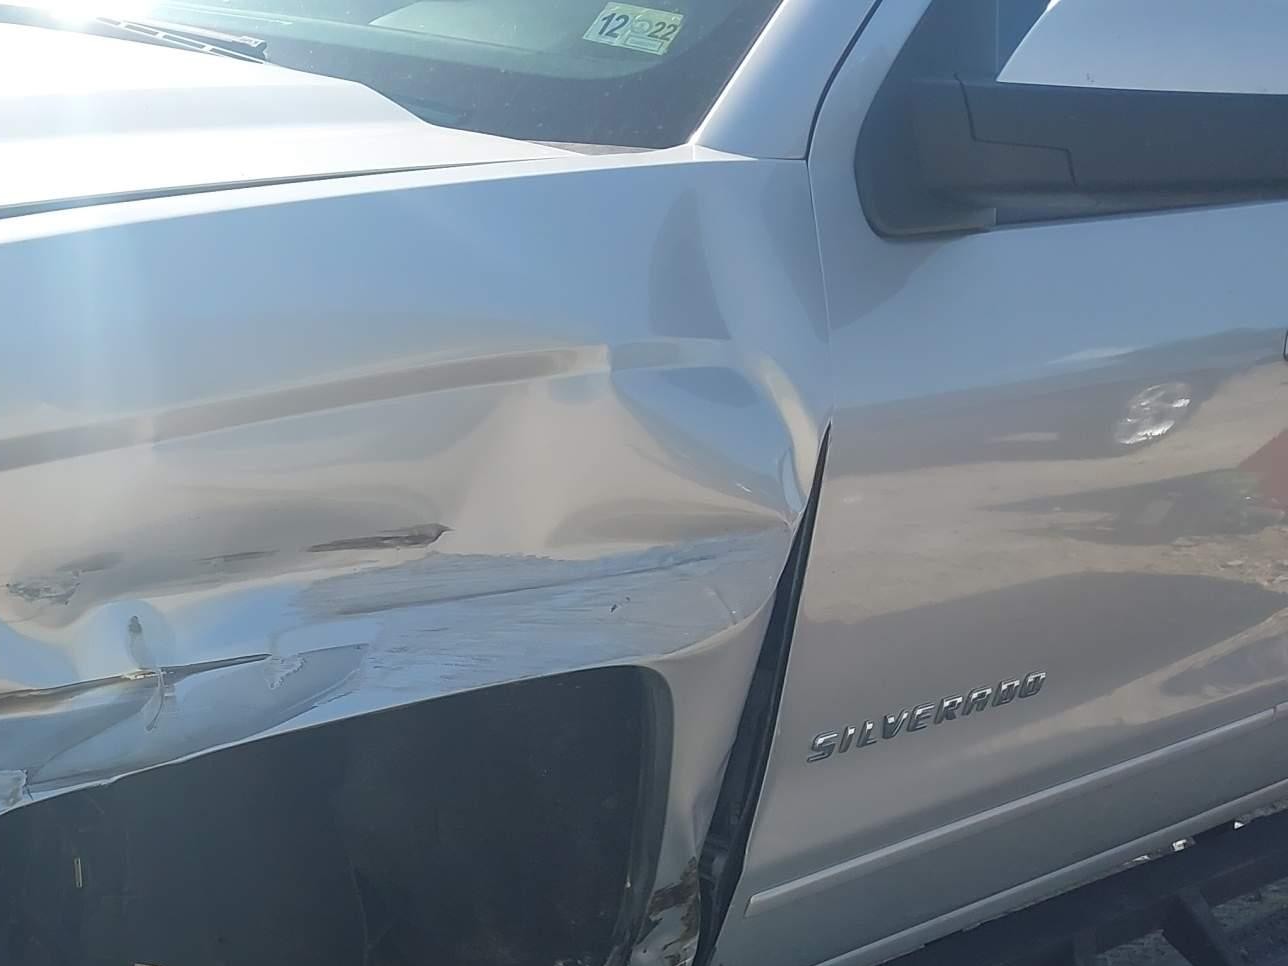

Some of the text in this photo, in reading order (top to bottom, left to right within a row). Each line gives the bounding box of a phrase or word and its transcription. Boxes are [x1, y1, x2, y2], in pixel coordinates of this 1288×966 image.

[598, 12, 679, 42] 12 22
[806, 671, 1047, 763] SILVERADO
